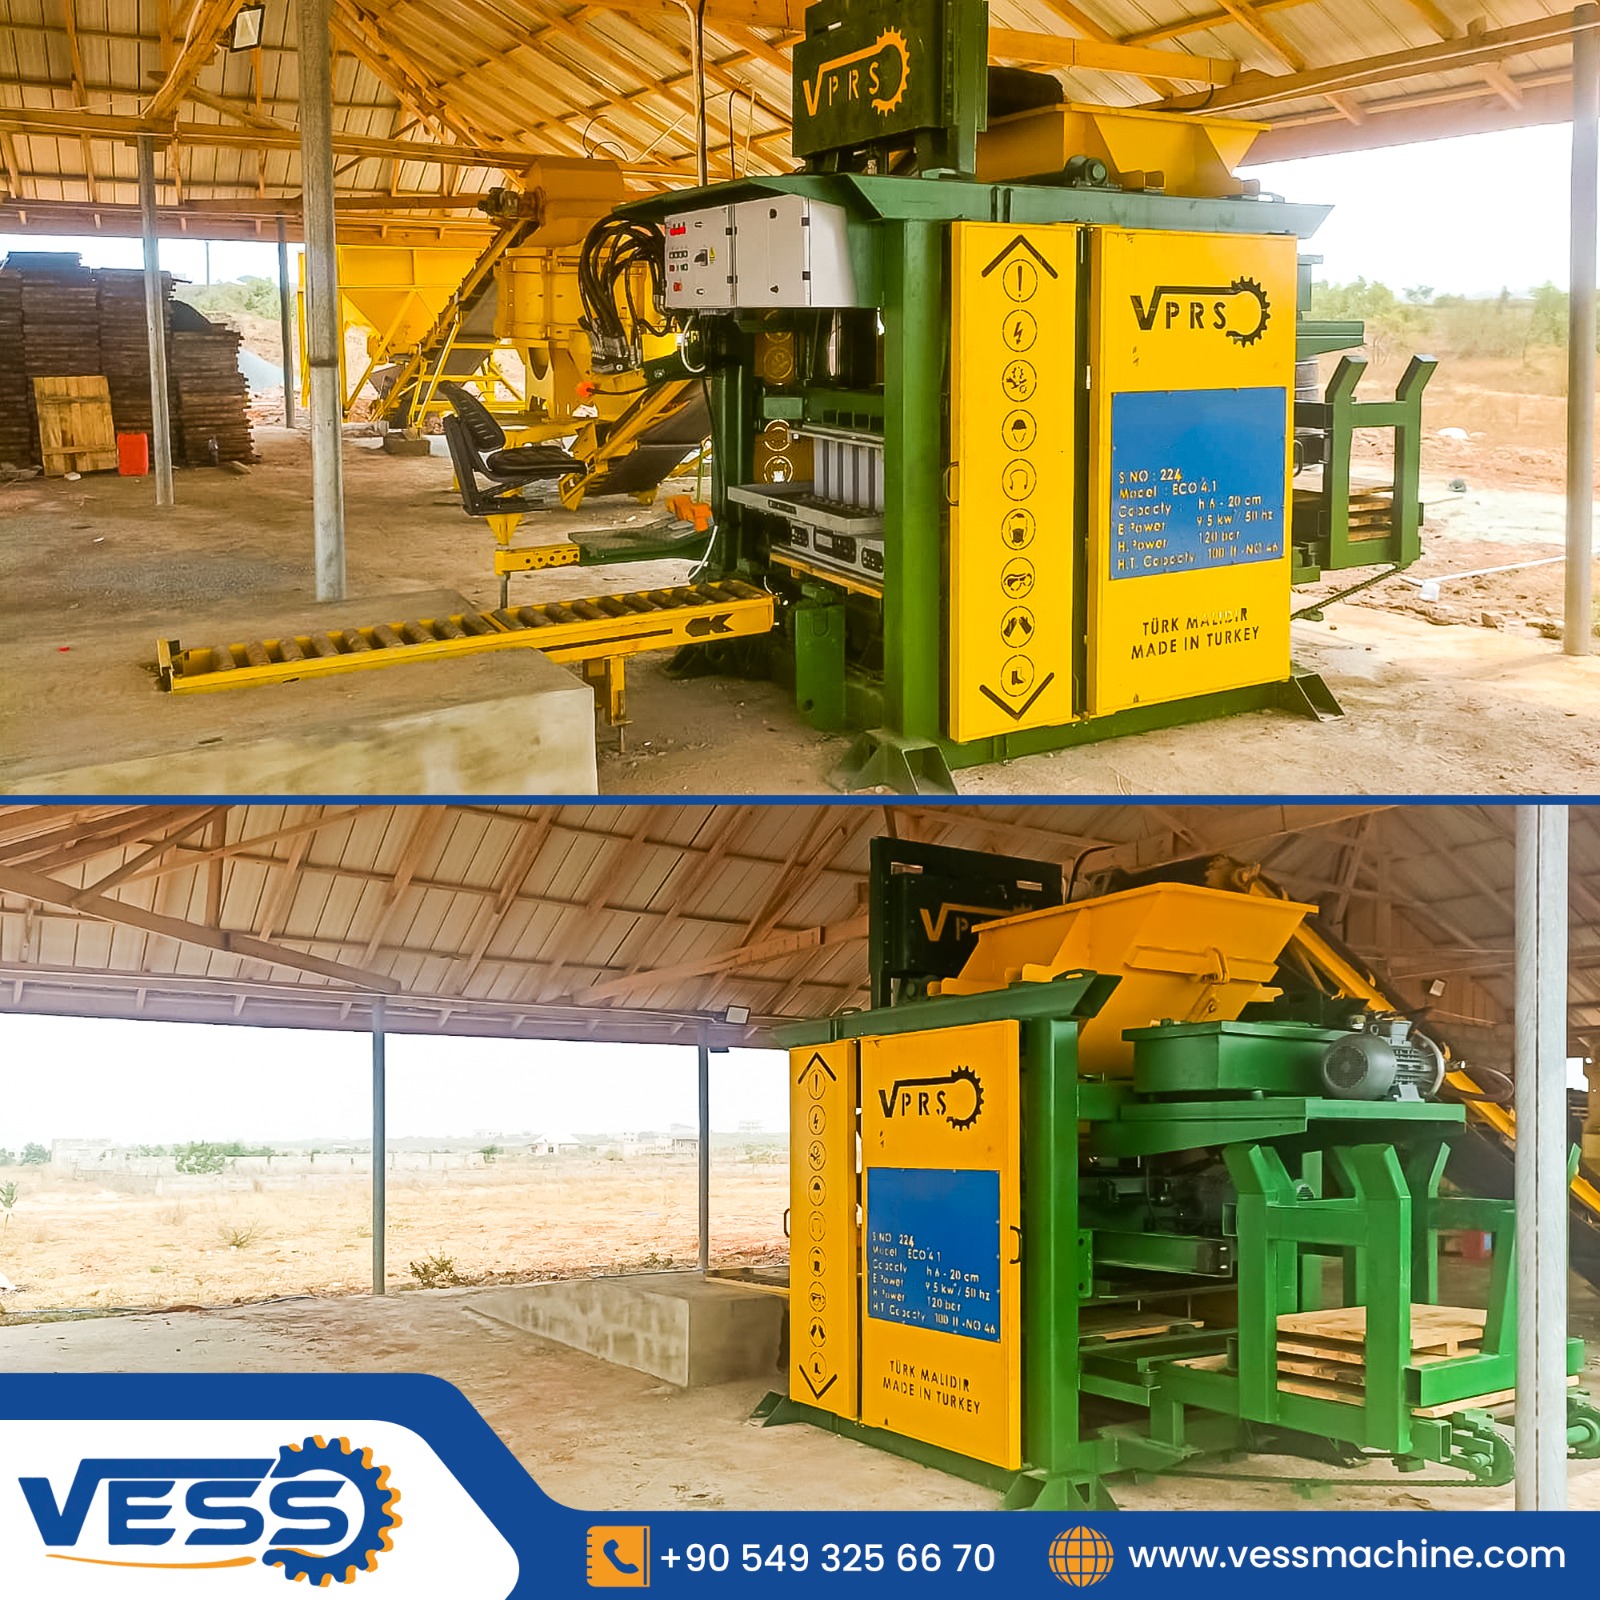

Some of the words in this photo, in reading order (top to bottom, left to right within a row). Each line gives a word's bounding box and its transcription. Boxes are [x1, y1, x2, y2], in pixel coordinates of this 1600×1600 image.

[803, 46, 886, 116] VPRS
[1130, 284, 1244, 333] VPRS
[1160, 469, 1182, 481] 224
[1172, 482, 1197, 495] ECO
[1143, 617, 1178, 636] TÜRK
[1131, 639, 1176, 660] MADE
[1184, 636, 1199, 650] IN
[1207, 626, 1260, 647] TURKEY
[878, 1076, 958, 1120] VPRS
[899, 1234, 914, 1247] 224
[907, 1249, 926, 1260] ECO
[964, 1274, 979, 1282] cm
[883, 1377, 914, 1396] MADE
[920, 1386, 931, 1400] IN
[936, 1391, 980, 1414] TURKEY
